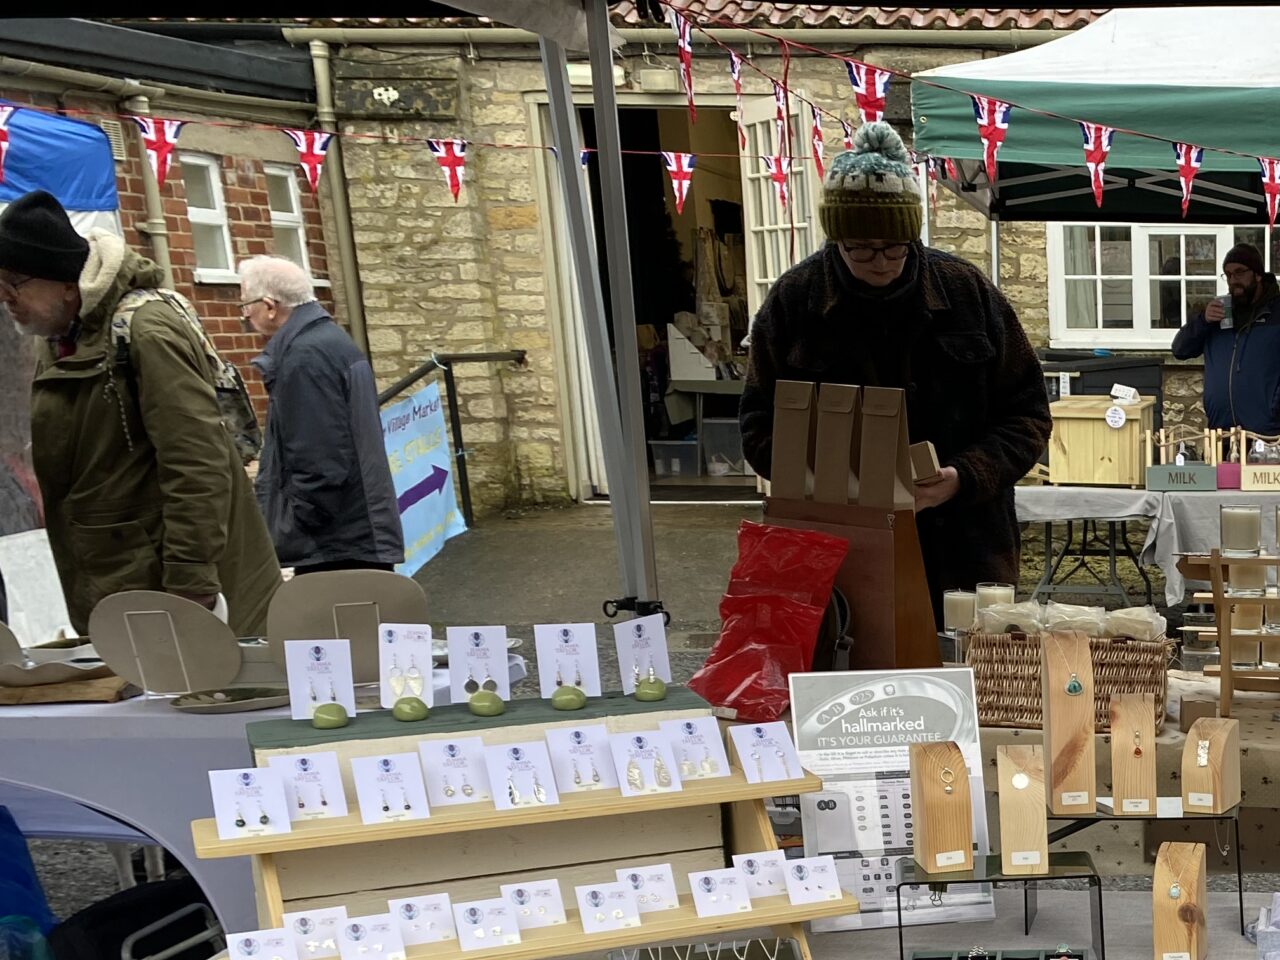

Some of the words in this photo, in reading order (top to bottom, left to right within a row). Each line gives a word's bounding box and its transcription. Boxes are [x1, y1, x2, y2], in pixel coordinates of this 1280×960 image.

[1167, 472, 1197, 485] MILK
[1252, 472, 1280, 485] MILK
[859, 708, 878, 718] Ask
[879, 707, 888, 717] if
[890, 706, 905, 716] it's
[841, 716, 925, 734] hallmarked
[817, 736, 837, 747] IT'S
[838, 735, 872, 746] YOUR
[874, 732, 942, 744] GUARANTEE
